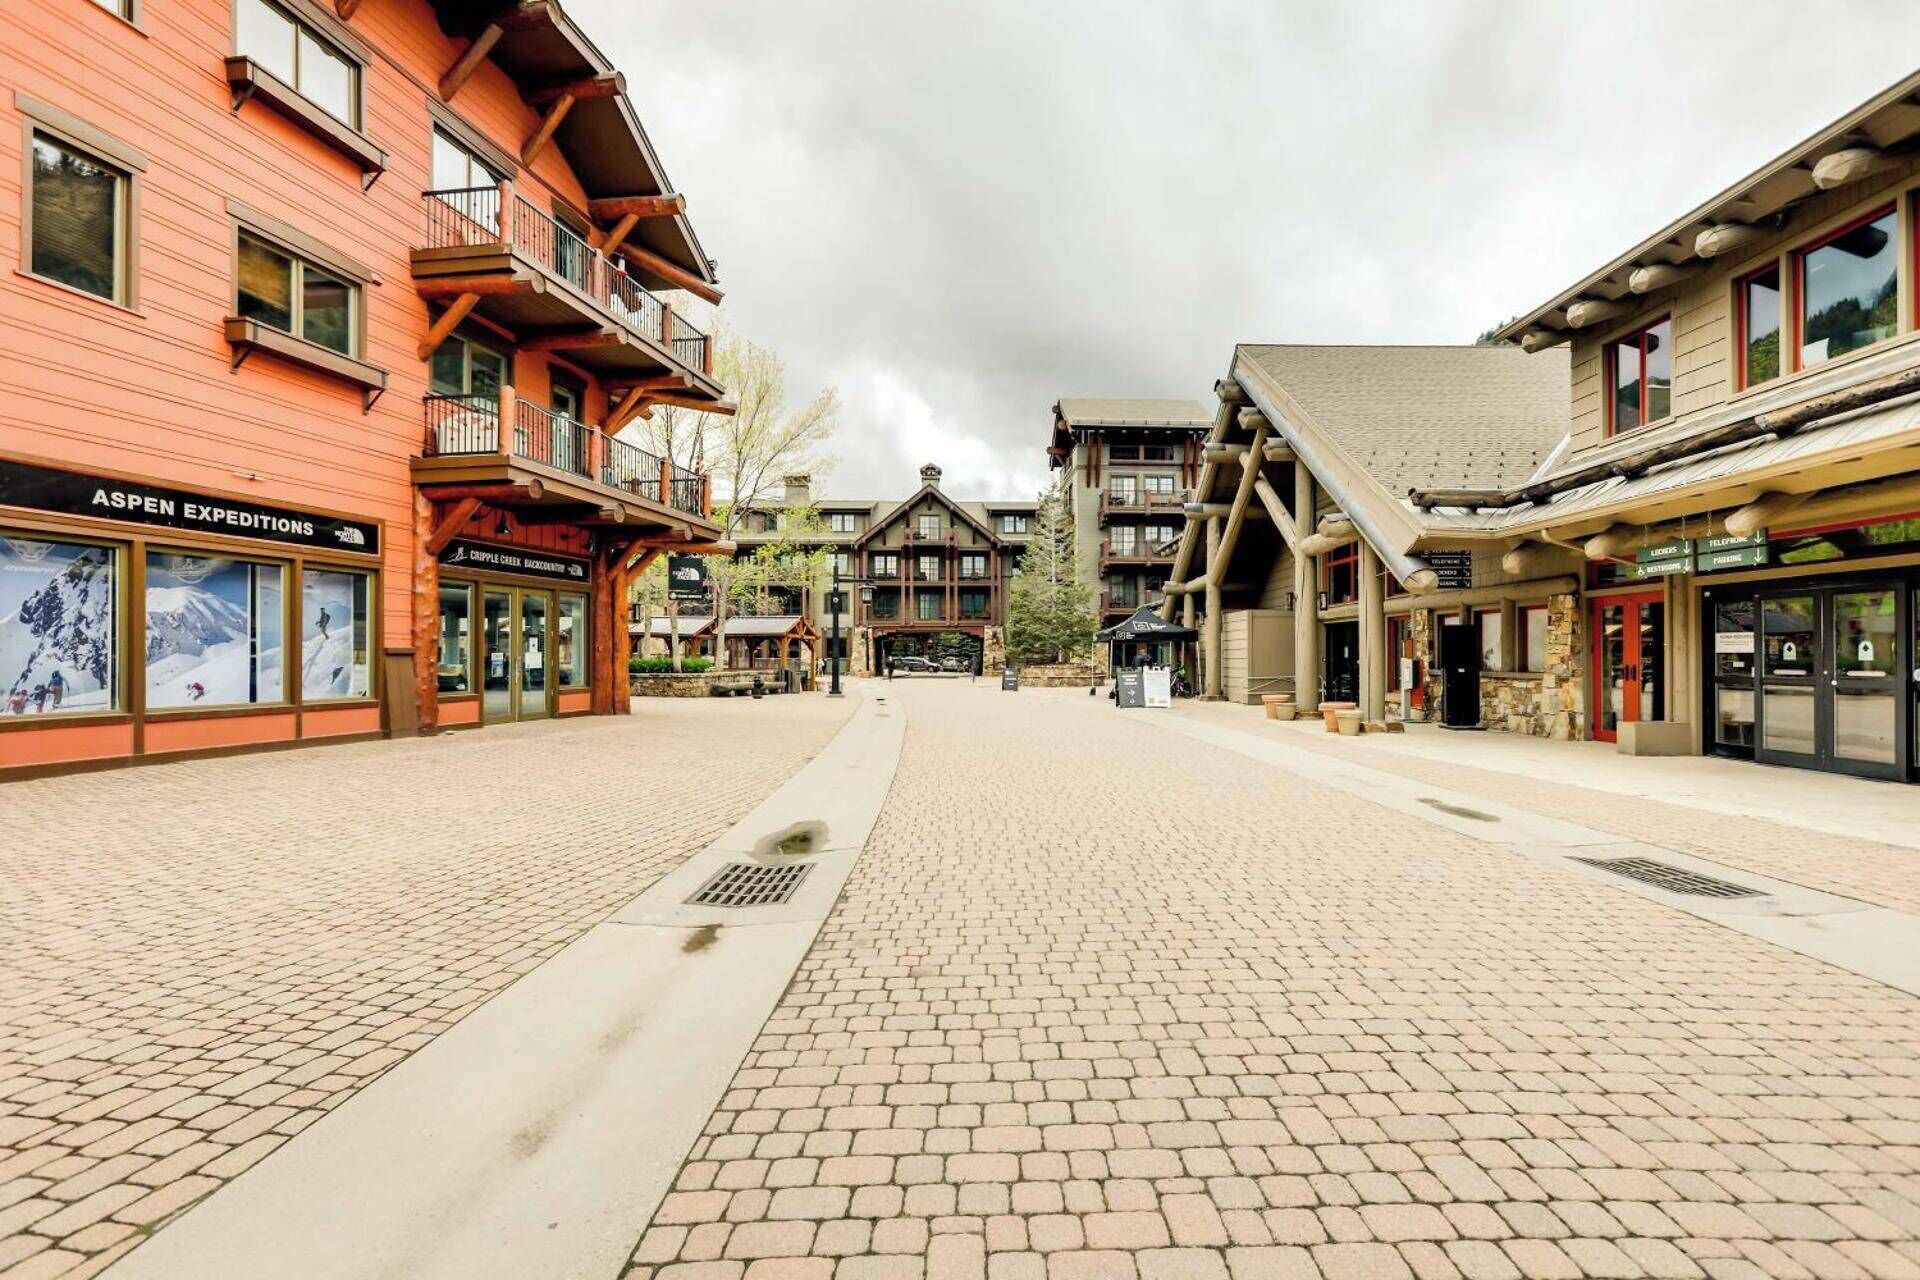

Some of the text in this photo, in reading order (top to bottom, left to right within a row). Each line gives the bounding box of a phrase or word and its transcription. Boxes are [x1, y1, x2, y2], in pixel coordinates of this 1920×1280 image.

[92, 489, 314, 536] ASPEN EXPEDITIONS
[1650, 546, 1678, 557] LOCKERS
[470, 549, 499, 563] CRIPPLE
[500, 554, 521, 567] CREEK
[524, 558, 566, 573] BACKCOUNTRY
[1713, 553, 1742, 565] PARKING
[1646, 563, 1681, 573] RESTROOMS
